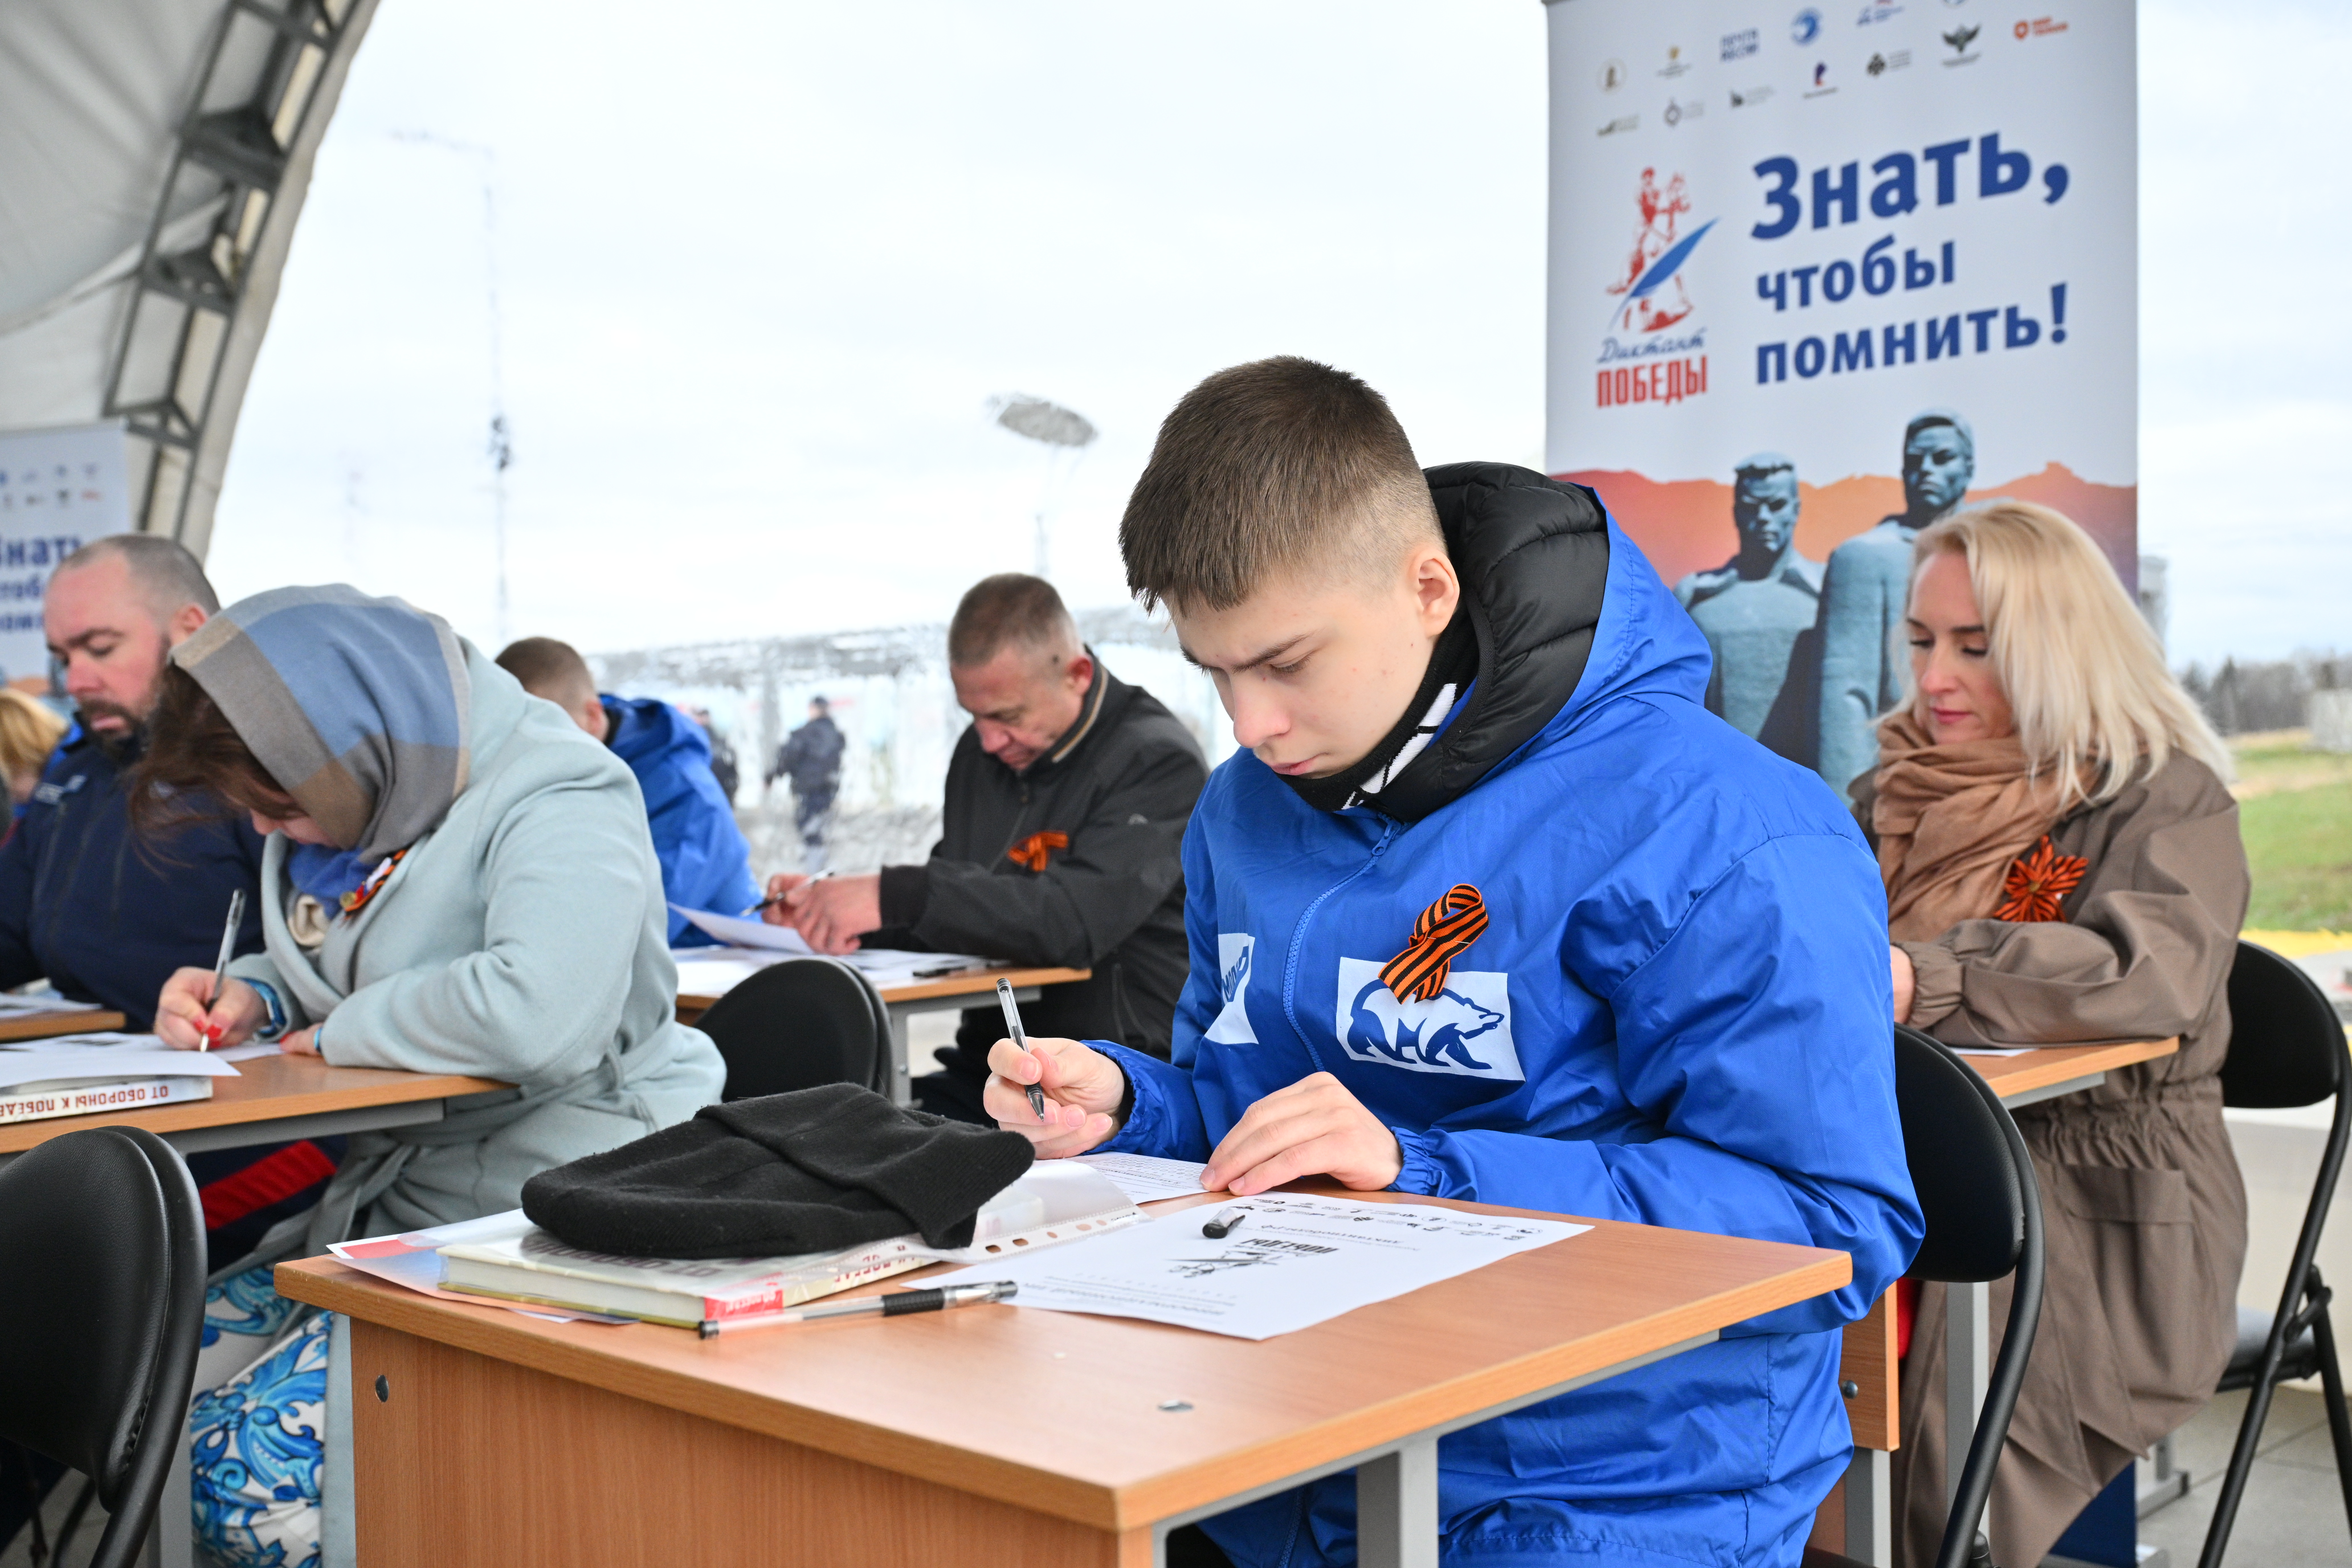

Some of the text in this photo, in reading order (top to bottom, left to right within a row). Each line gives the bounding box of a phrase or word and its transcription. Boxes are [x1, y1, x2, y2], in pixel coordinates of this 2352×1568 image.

[1750, 132, 2070, 240] Знать,
[1757, 234, 1955, 312] чтобы
[1757, 282, 2067, 385] помнить!
[1597, 355, 1706, 407] ПОБЕДЫ
[0, 537, 81, 564] нат
[62, 1097, 71, 1109] К
[75, 1088, 145, 1109] ОБОРОНЫ
[150, 1085, 169, 1099] ОТ
